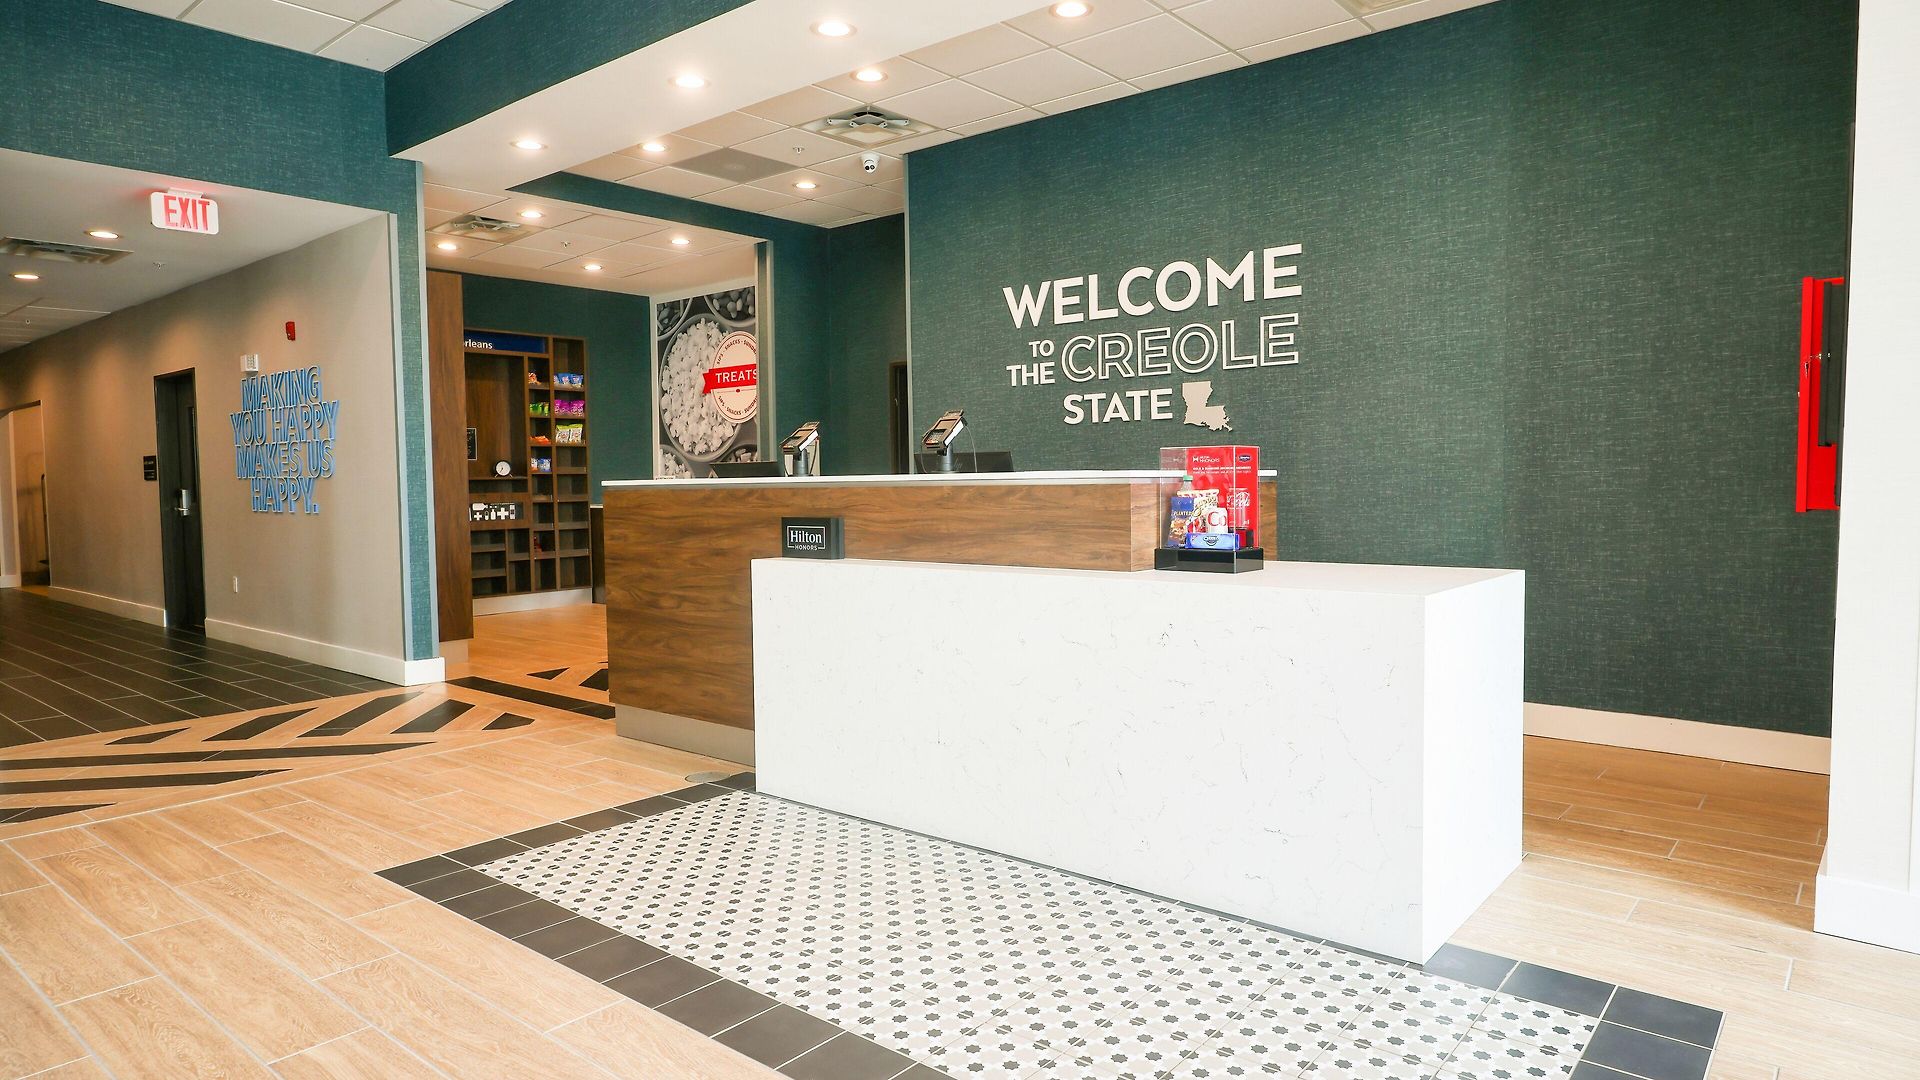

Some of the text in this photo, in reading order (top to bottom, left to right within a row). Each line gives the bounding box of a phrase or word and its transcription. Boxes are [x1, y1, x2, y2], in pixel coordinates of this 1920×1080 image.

[163, 195, 210, 231] EXIT
[1002, 243, 1302, 329] WELCOME
[463, 339, 493, 350] rleans
[1006, 312, 1299, 387] THE CREOLE
[1028, 339, 1055, 358] TO
[241, 365, 322, 412] MAKING
[715, 369, 757, 384] TREATS
[230, 400, 339, 447] YOU HAPPY
[1063, 388, 1174, 425] STATE
[235, 438, 335, 479] MAKES US
[251, 476, 319, 514] HAPPY.
[790, 530, 822, 544] Hilton
